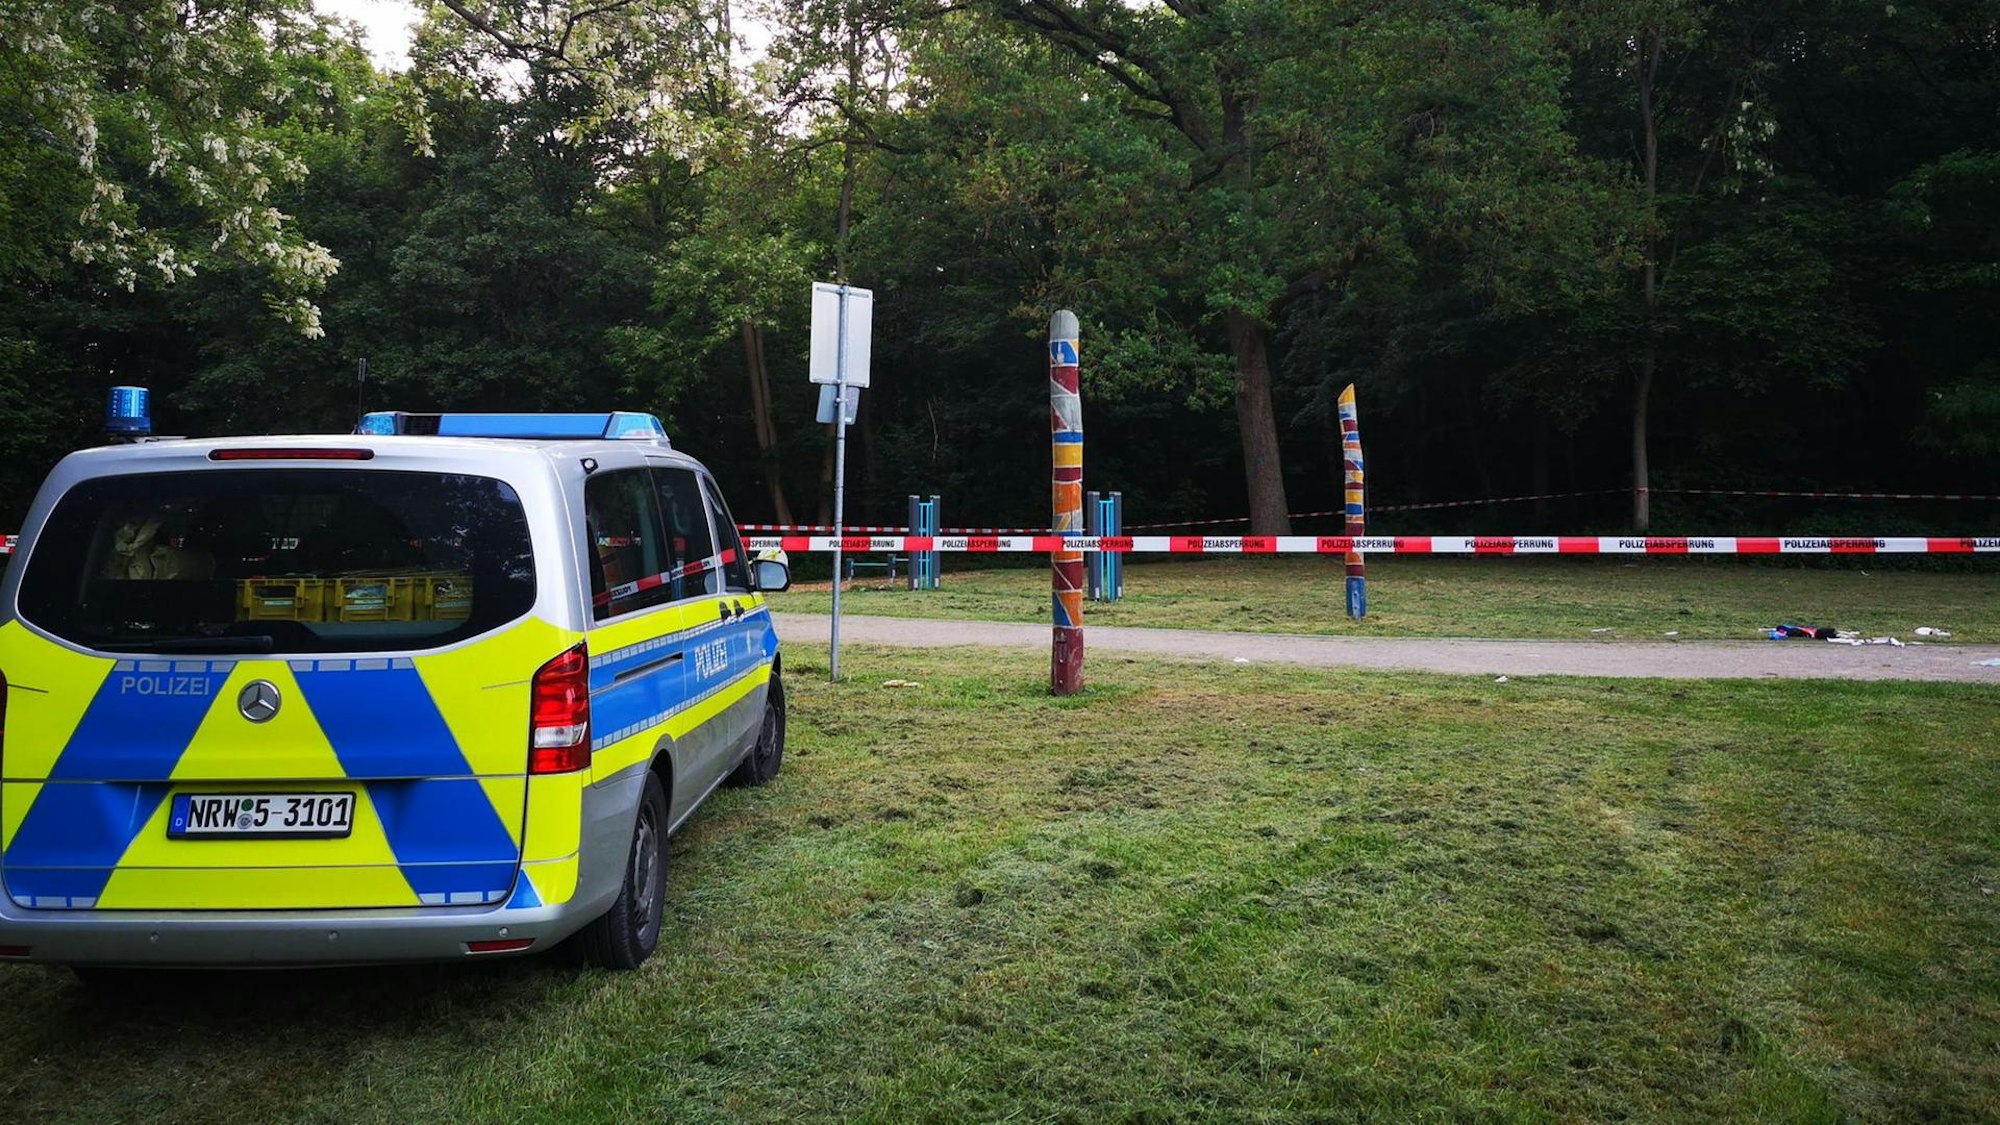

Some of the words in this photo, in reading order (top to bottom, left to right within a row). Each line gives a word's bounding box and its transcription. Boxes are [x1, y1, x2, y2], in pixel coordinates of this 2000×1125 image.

[828, 539, 895, 548] POLIZEIABSPERRUNG
[942, 539, 1012, 548] POLIZEIABSPERRUNG
[1062, 539, 1134, 549] POLIZEIABSPERRUNG
[1187, 539, 1265, 549] POLIZEIABSPERRUNG
[1321, 539, 1405, 548] POLIZEIABSPERRUNG
[1464, 538, 1554, 548] POLIZEIABSPERRUNG
[1619, 538, 1715, 549] POLIZEIABSPERRUNG
[1784, 538, 1886, 548] POLIZEIABSPERRUNG
[694, 637, 728, 683] POLIZEI
[121, 676, 211, 696] POLIZEI
[187, 799, 240, 828] NRW
[253, 797, 348, 827] 5-3101
[175, 818, 183, 827] D
